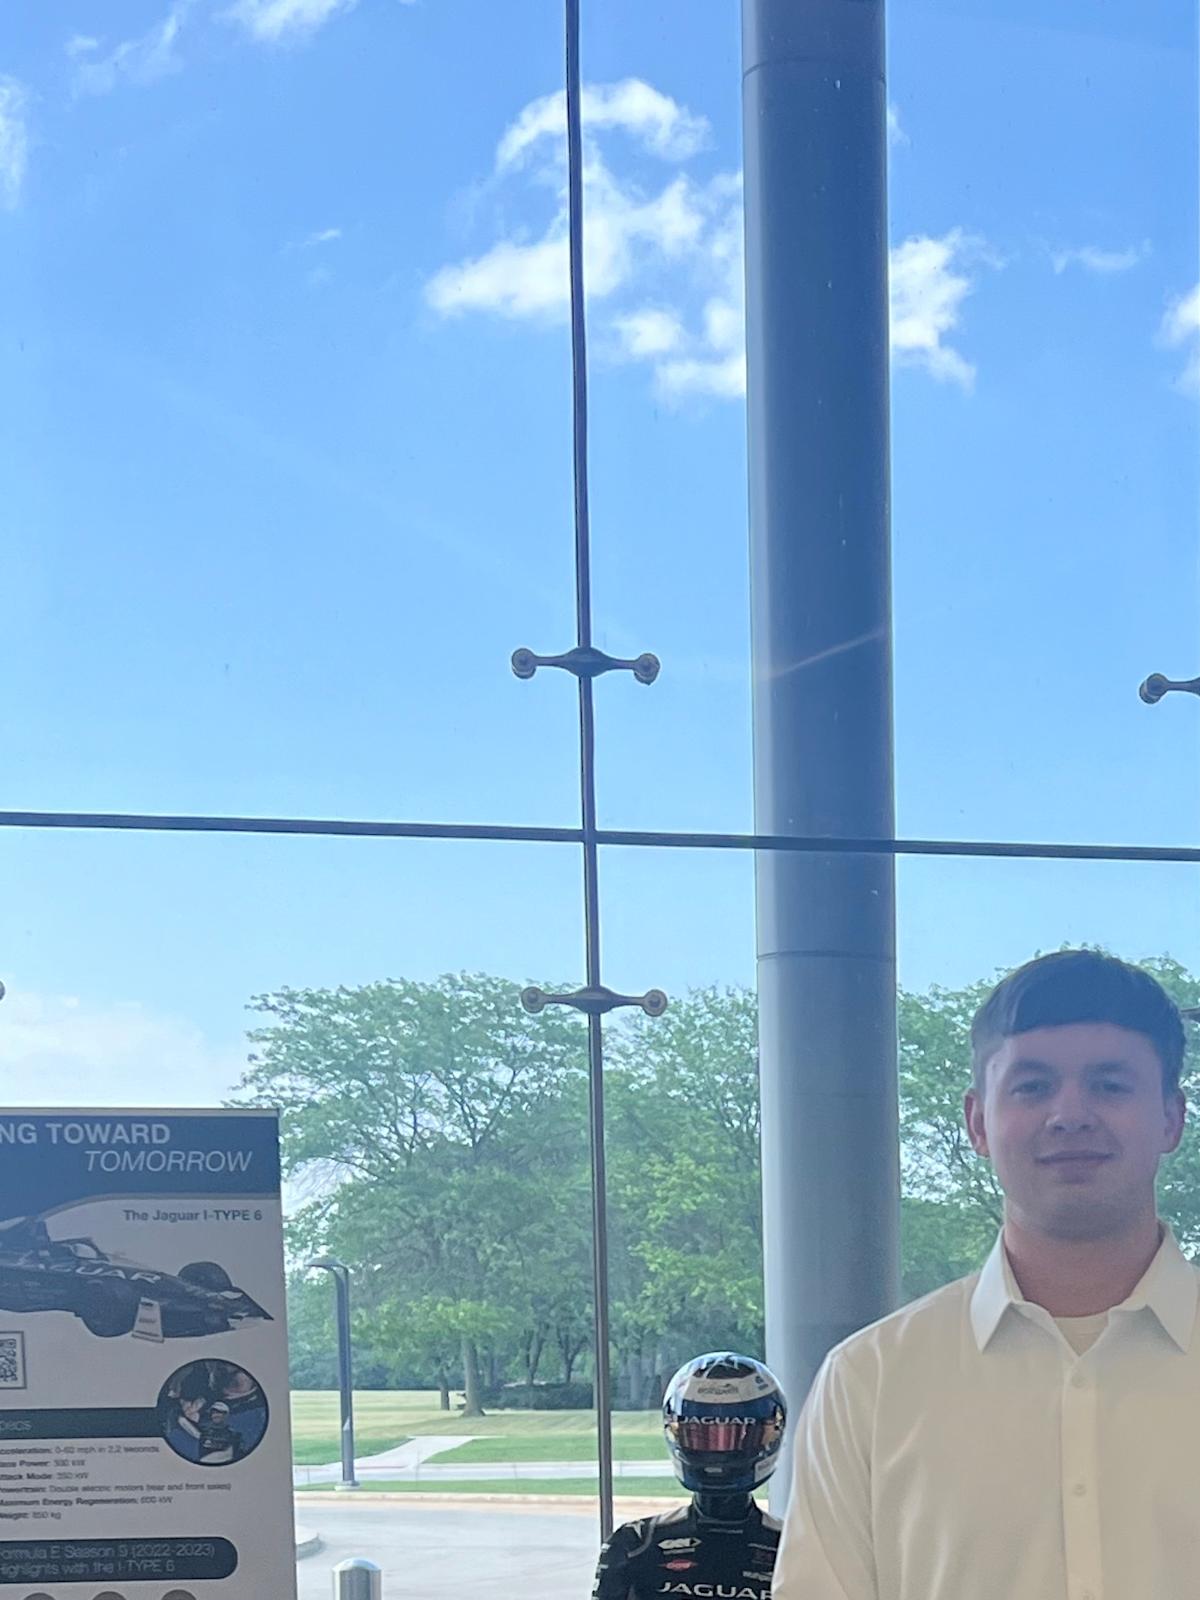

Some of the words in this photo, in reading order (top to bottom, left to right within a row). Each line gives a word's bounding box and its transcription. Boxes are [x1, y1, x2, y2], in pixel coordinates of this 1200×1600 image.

[0, 1123, 37, 1144] NG
[45, 1123, 171, 1144] TOWARD
[85, 1150, 253, 1172] TOMORROW
[124, 1209, 149, 1221] The
[152, 1209, 199, 1223] Jaguar
[204, 1208, 250, 1221] I-TYPE
[253, 1208, 262, 1220] 6
[680, 1416, 756, 1425] JAGUAR
[0, 1447, 52, 1455] cceleration:
[50, 1546, 60, 1558] E
[64, 1545, 116, 1558] Season
[132, 1543, 216, 1558] (2022-2023)
[62, 1562, 90, 1575] with
[93, 1561, 114, 1574] the
[117, 1559, 163, 1573] I-TYPE
[166, 1559, 176, 1572] 6
